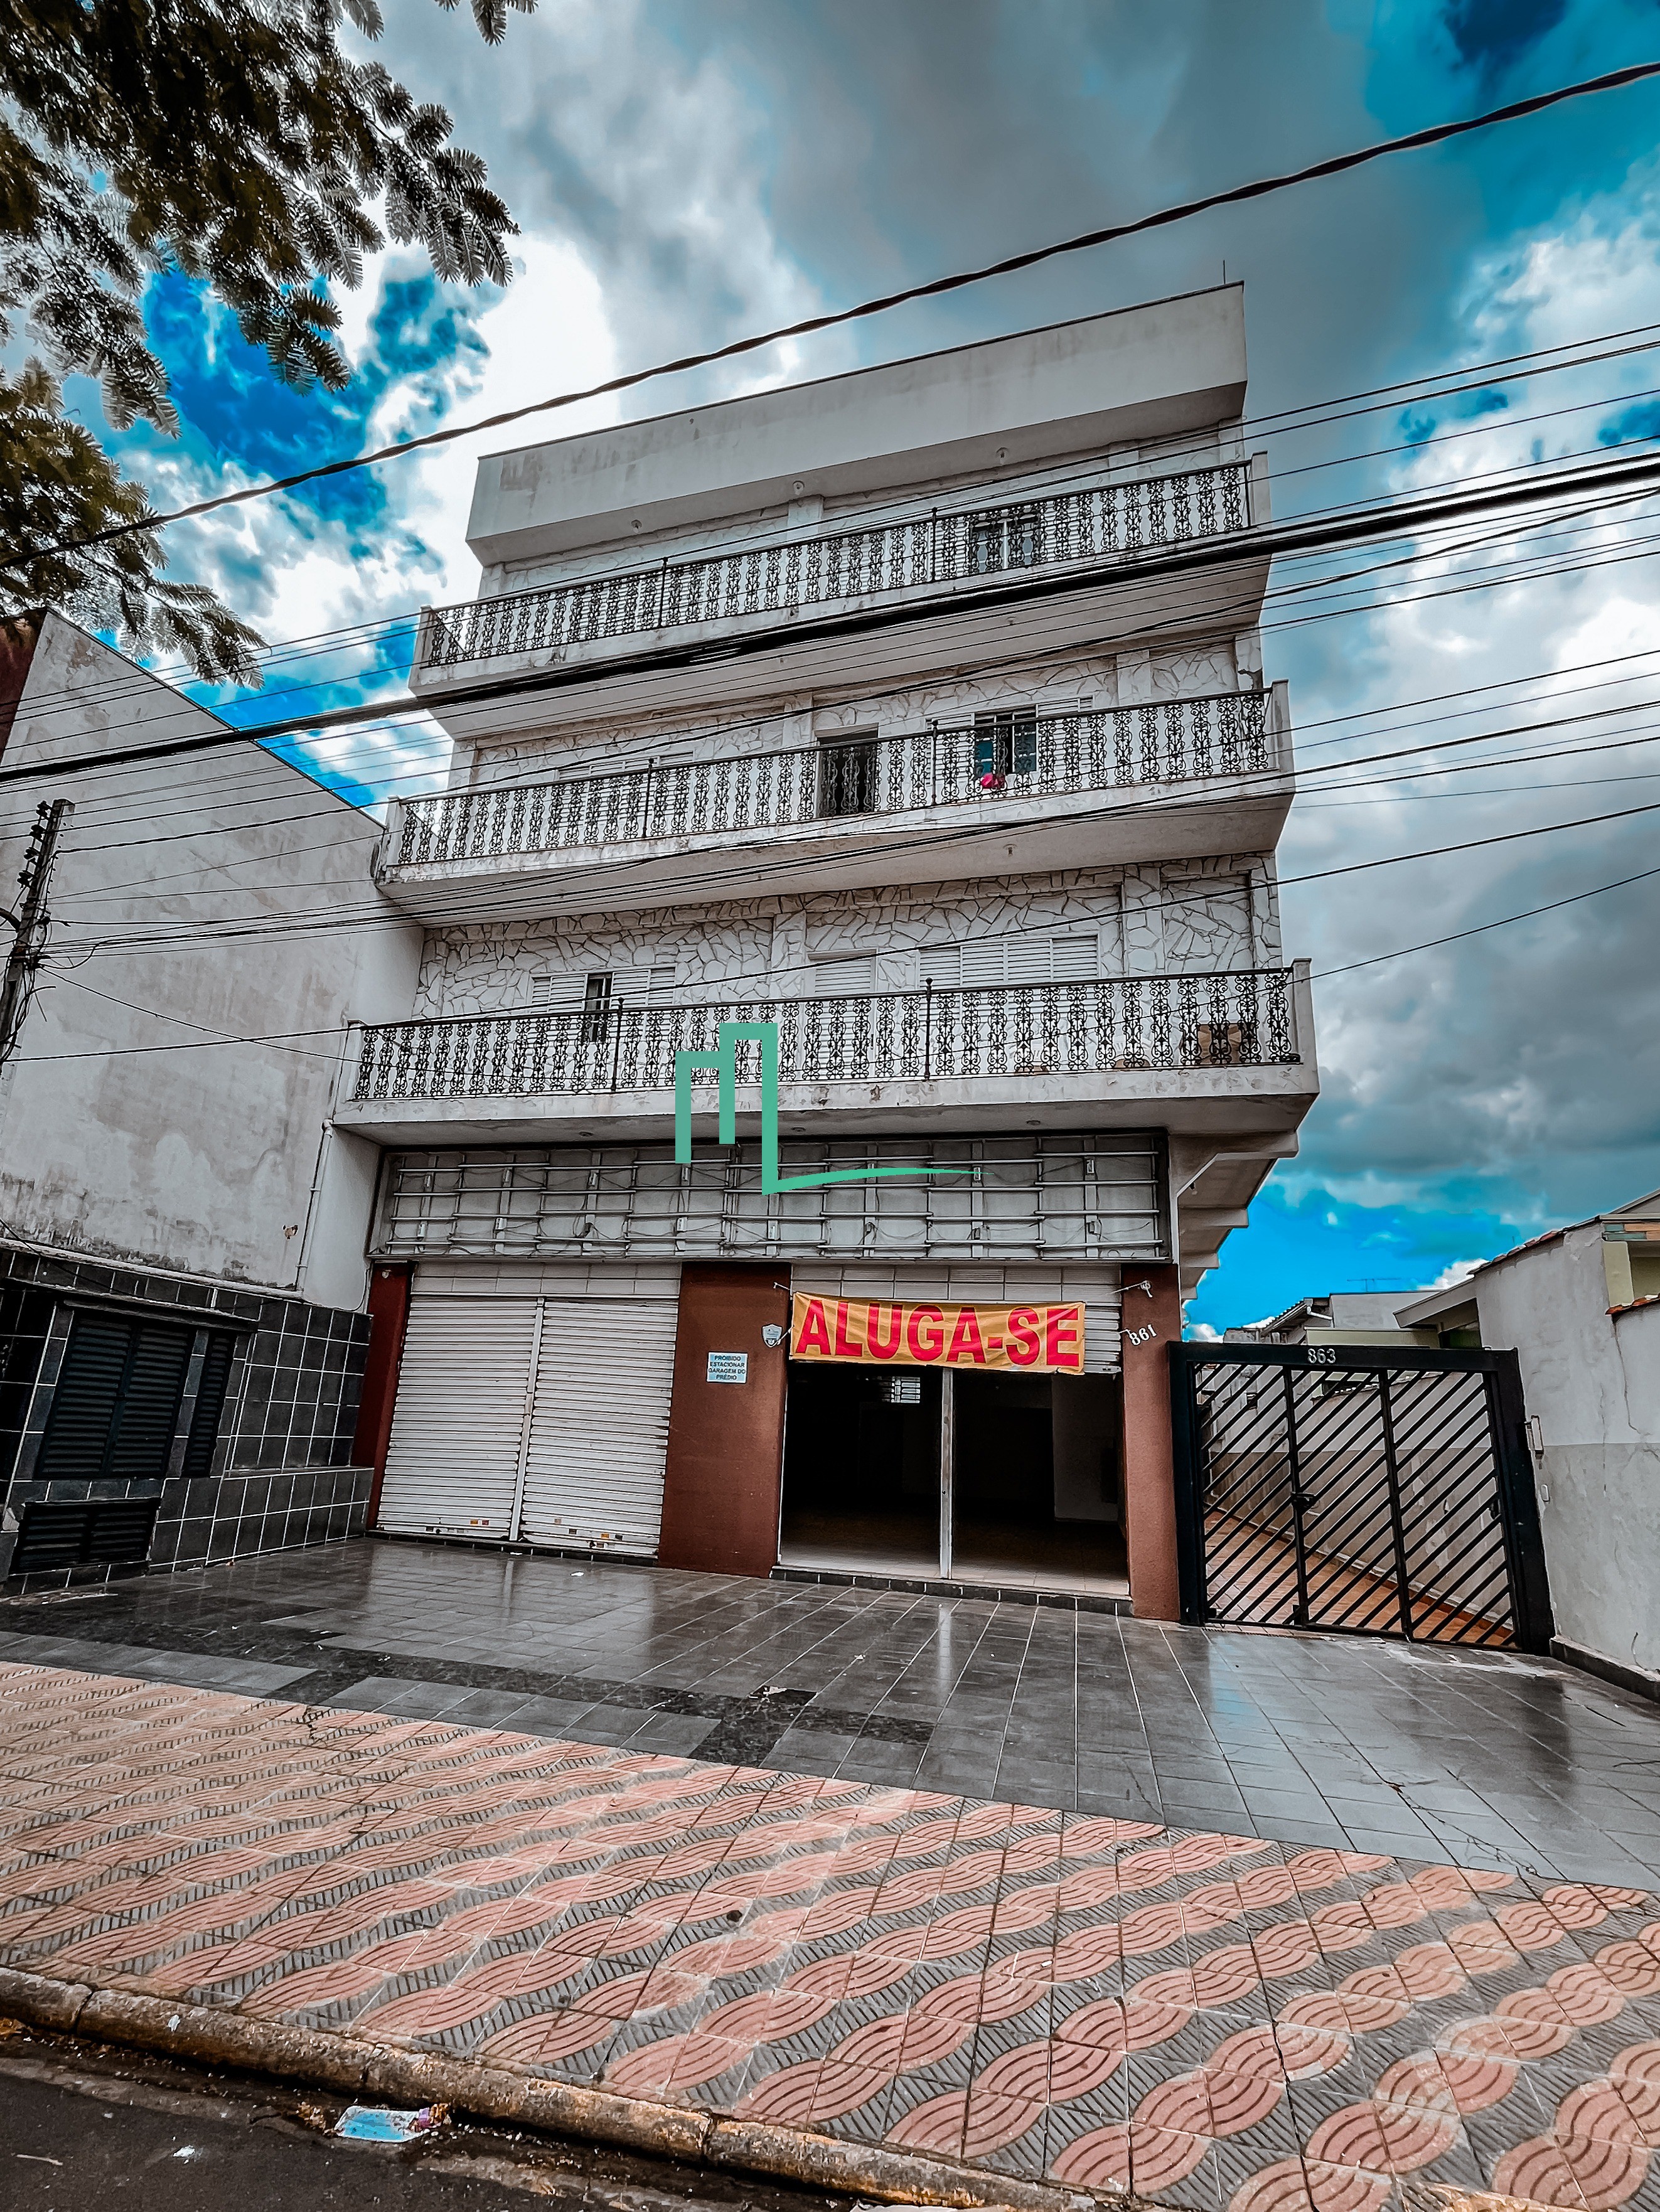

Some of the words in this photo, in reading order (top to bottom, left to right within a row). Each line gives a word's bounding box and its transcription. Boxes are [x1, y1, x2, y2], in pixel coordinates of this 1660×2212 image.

[795, 1299, 1079, 1367] ALUGA-SE
[1129, 1324, 1157, 1346] 861
[1307, 1348, 1336, 1364] 863
